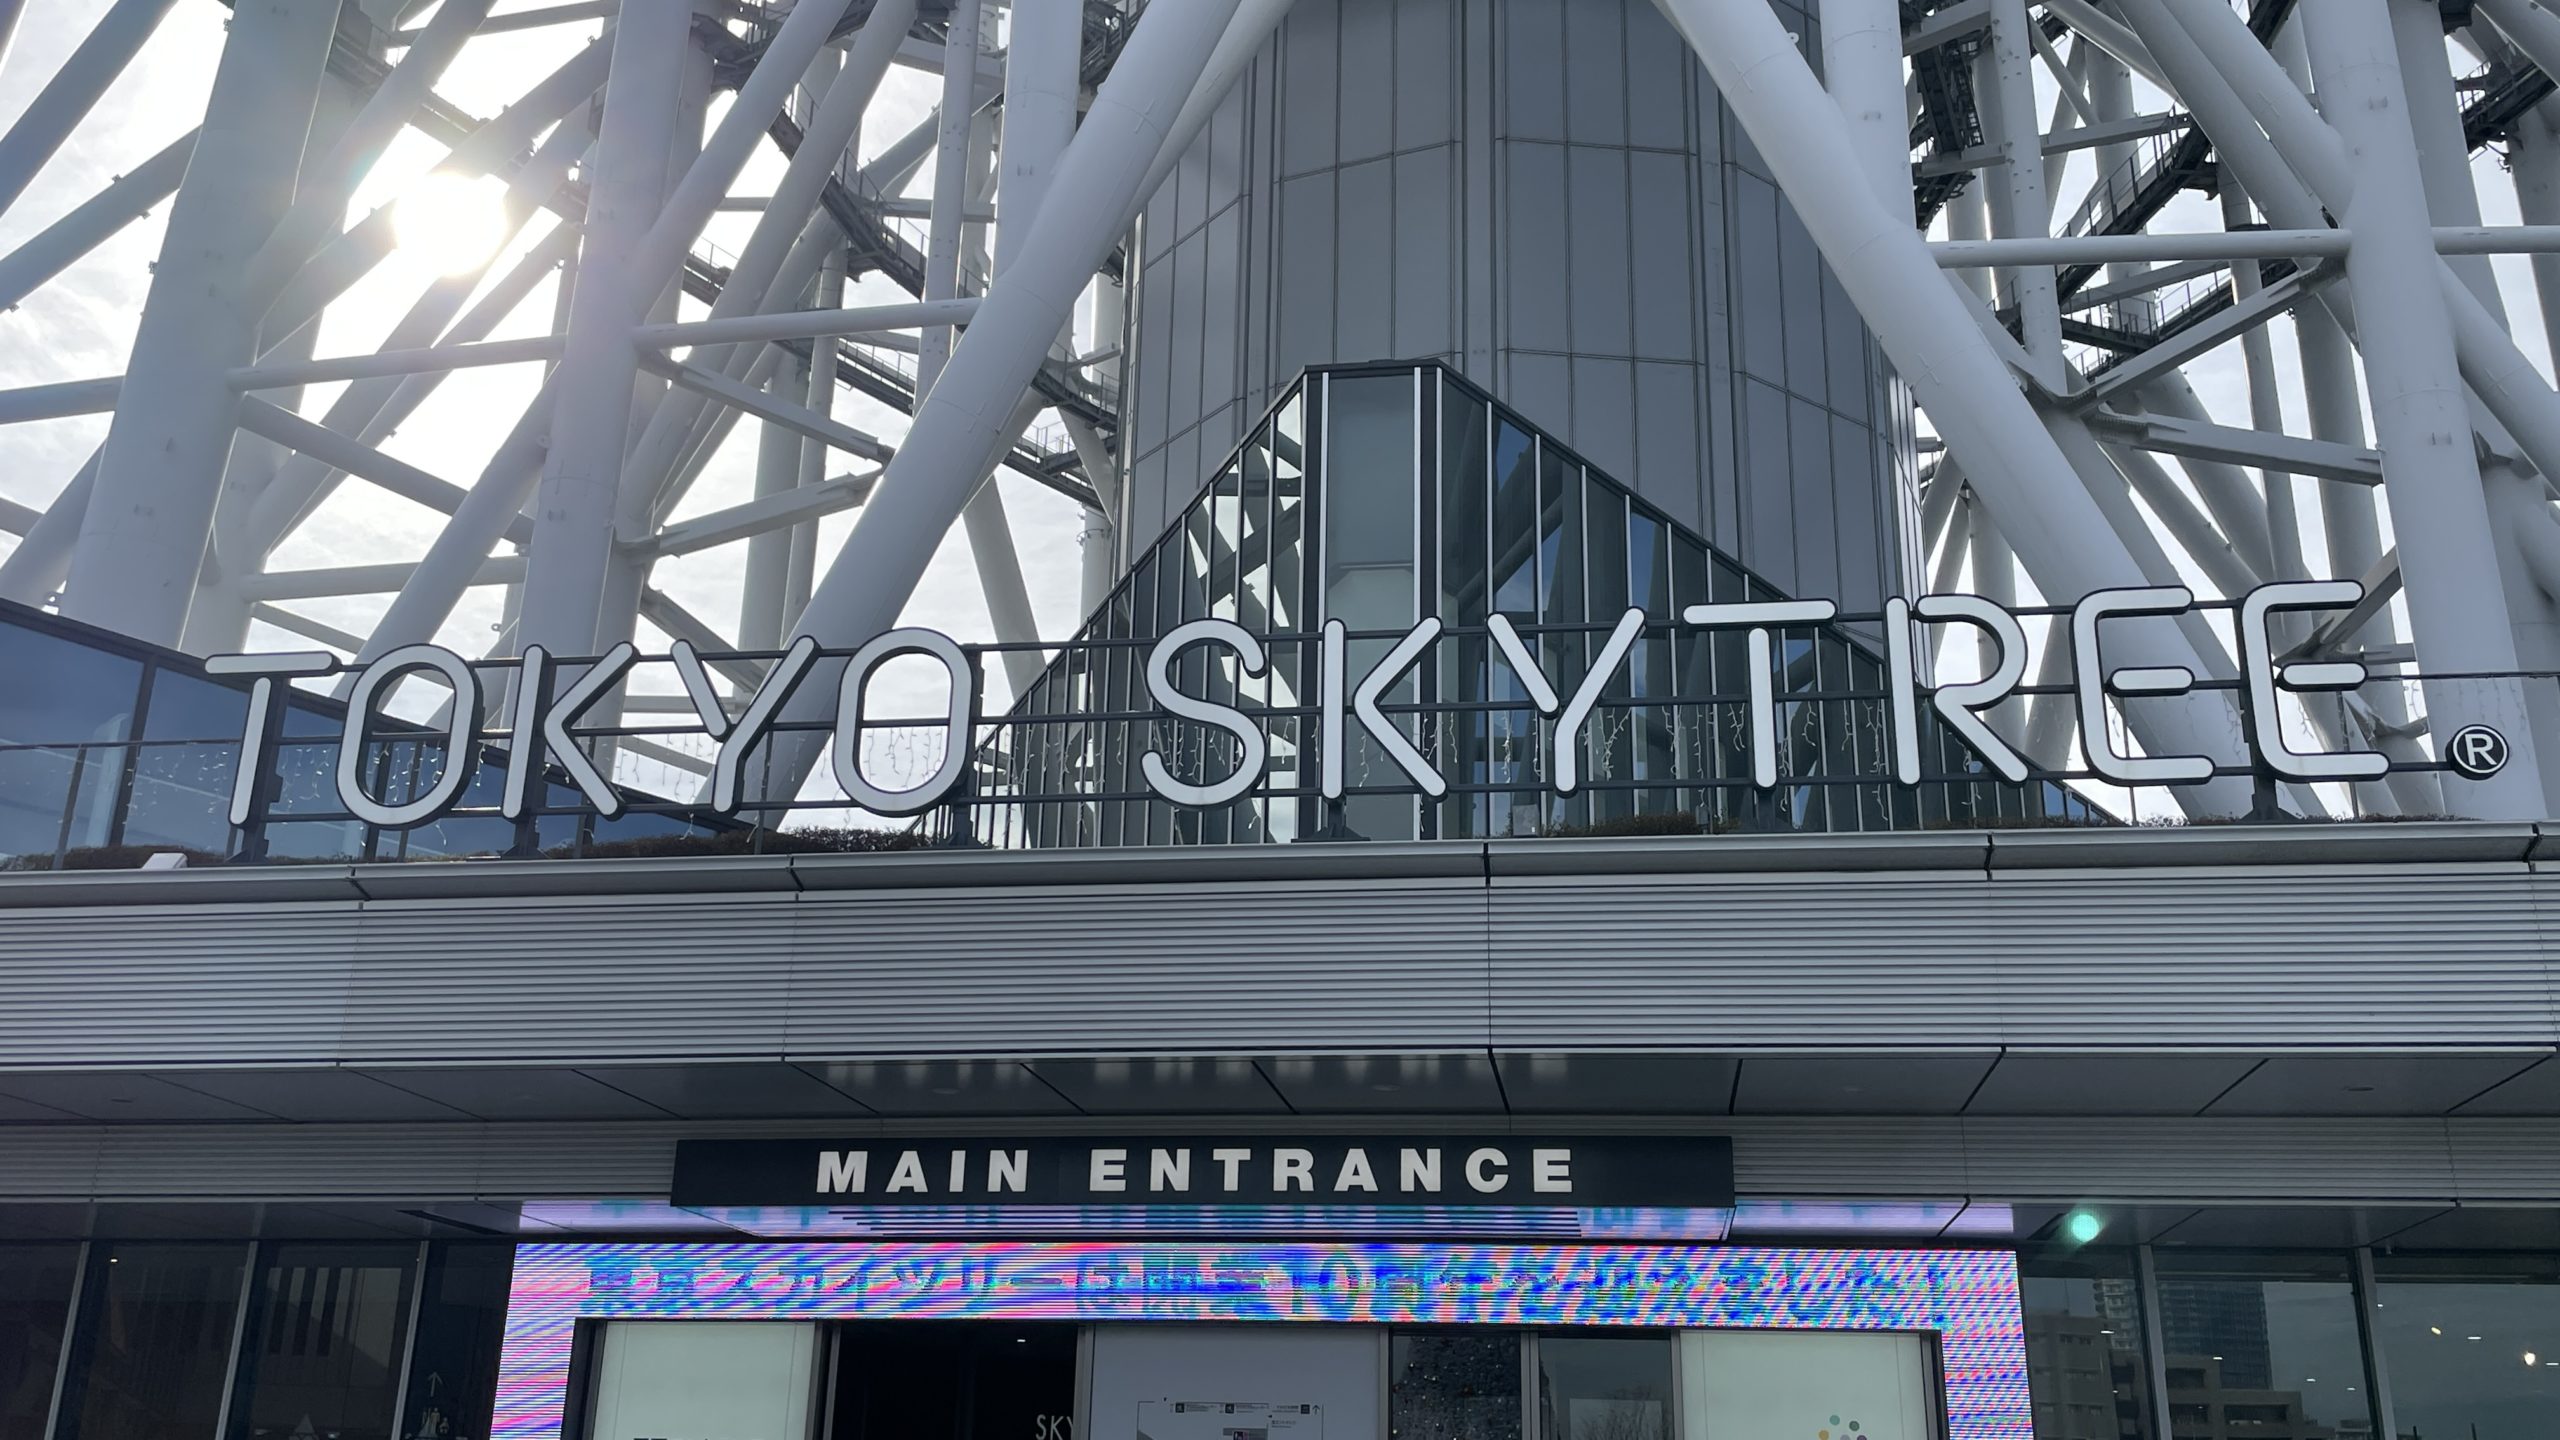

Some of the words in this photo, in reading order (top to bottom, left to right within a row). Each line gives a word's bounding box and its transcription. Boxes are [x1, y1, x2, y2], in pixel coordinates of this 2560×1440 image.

[204, 627, 974, 828] TOKYO
[816, 1149, 1029, 1194] MAIN
[1089, 1148, 1574, 1194] ENTRANCE
